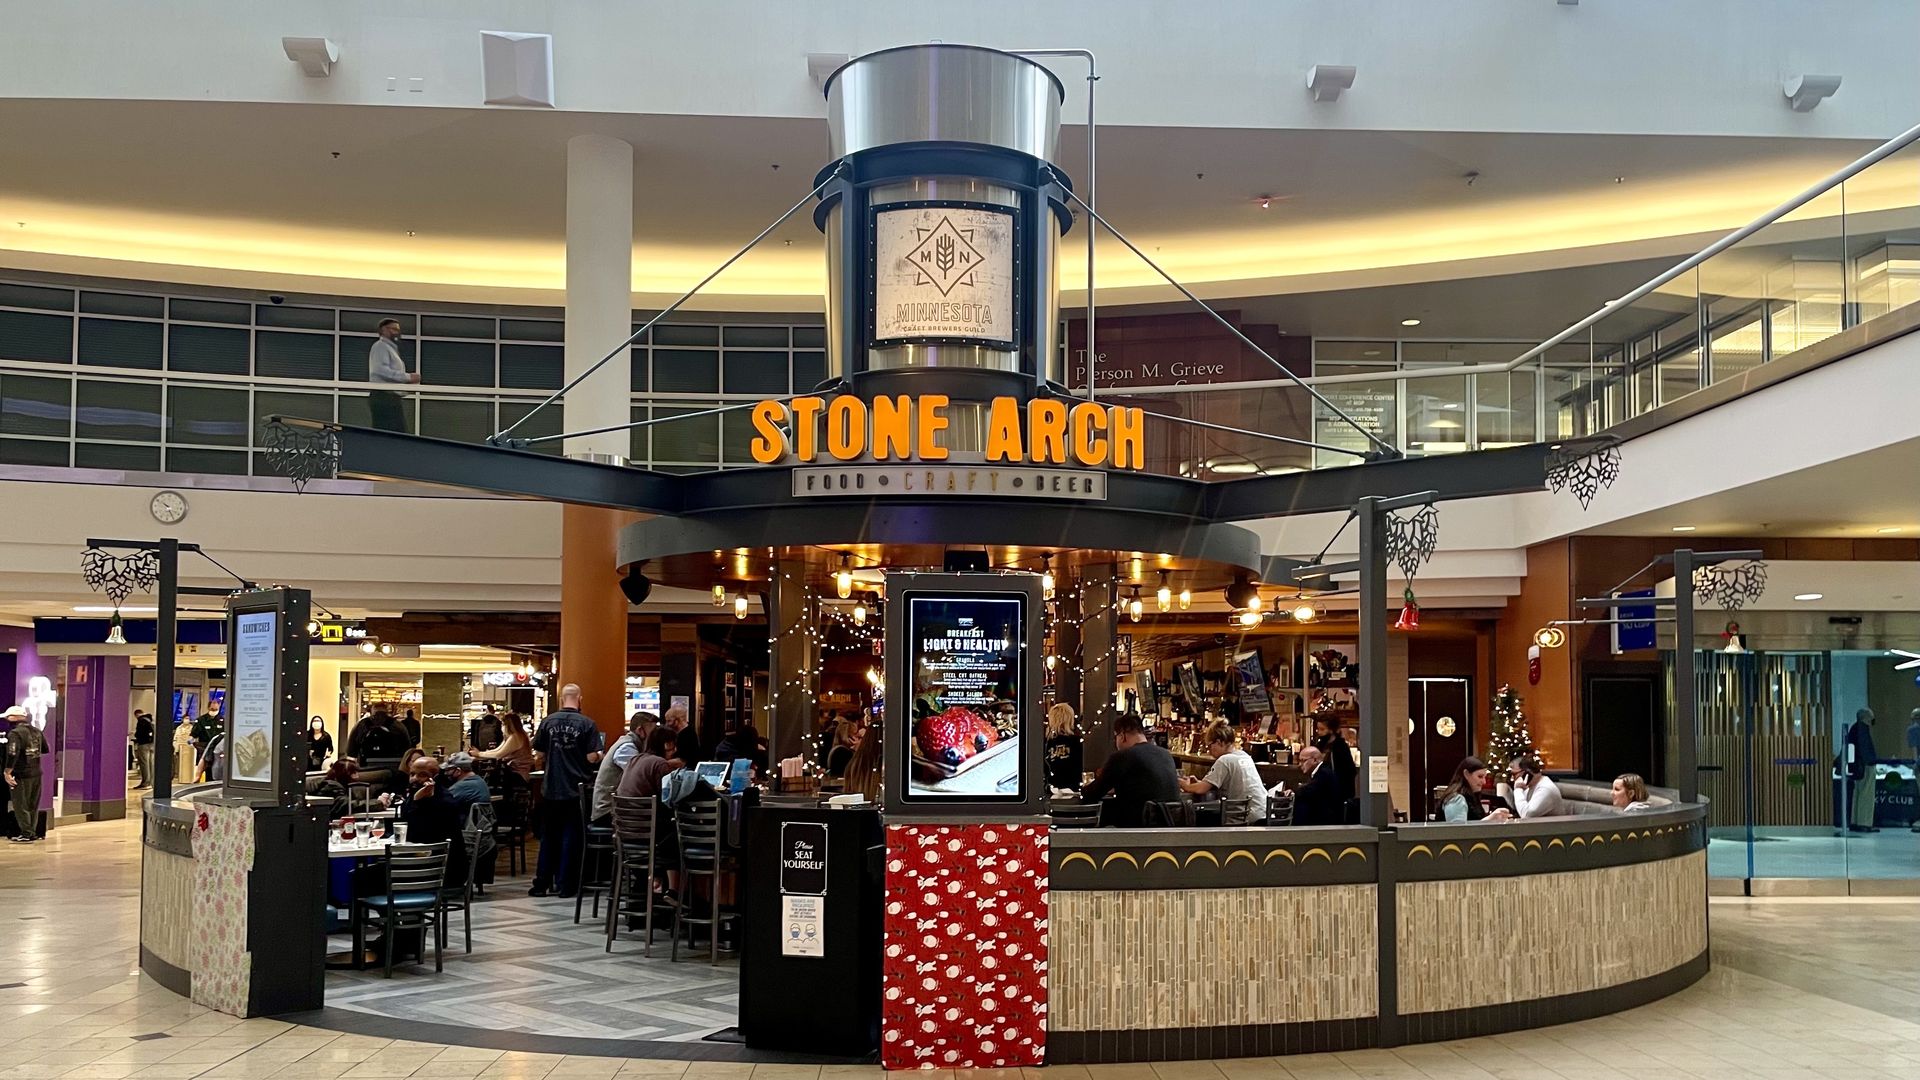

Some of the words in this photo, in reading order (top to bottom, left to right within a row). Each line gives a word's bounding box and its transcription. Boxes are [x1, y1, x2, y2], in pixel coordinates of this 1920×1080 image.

[920, 250, 932, 263] M
[959, 251, 970, 264] N
[896, 302, 993, 325] MINNESOTA
[1075, 348, 1107, 364] Te
[1075, 366, 1134, 381] Person
[1141, 363, 1164, 378] M.
[1170, 361, 1225, 378] Grieve
[750, 394, 949, 464] STONE
[985, 396, 1144, 471] ARCH
[806, 472, 865, 491] FOOD
[903, 470, 999, 492] CRAFT
[1035, 473, 1094, 494] BEER
[946, 629, 985, 638] BREAKFAST
[923, 638, 952, 651] LIGHT
[954, 639, 962, 650] &
[963, 638, 1008, 651] HEALTHY
[549, 724, 580, 738] FULTON
[1888, 795, 1915, 805] CLUB
[794, 850, 813, 860] SEAT
[783, 860, 825, 870] YOURSELF
